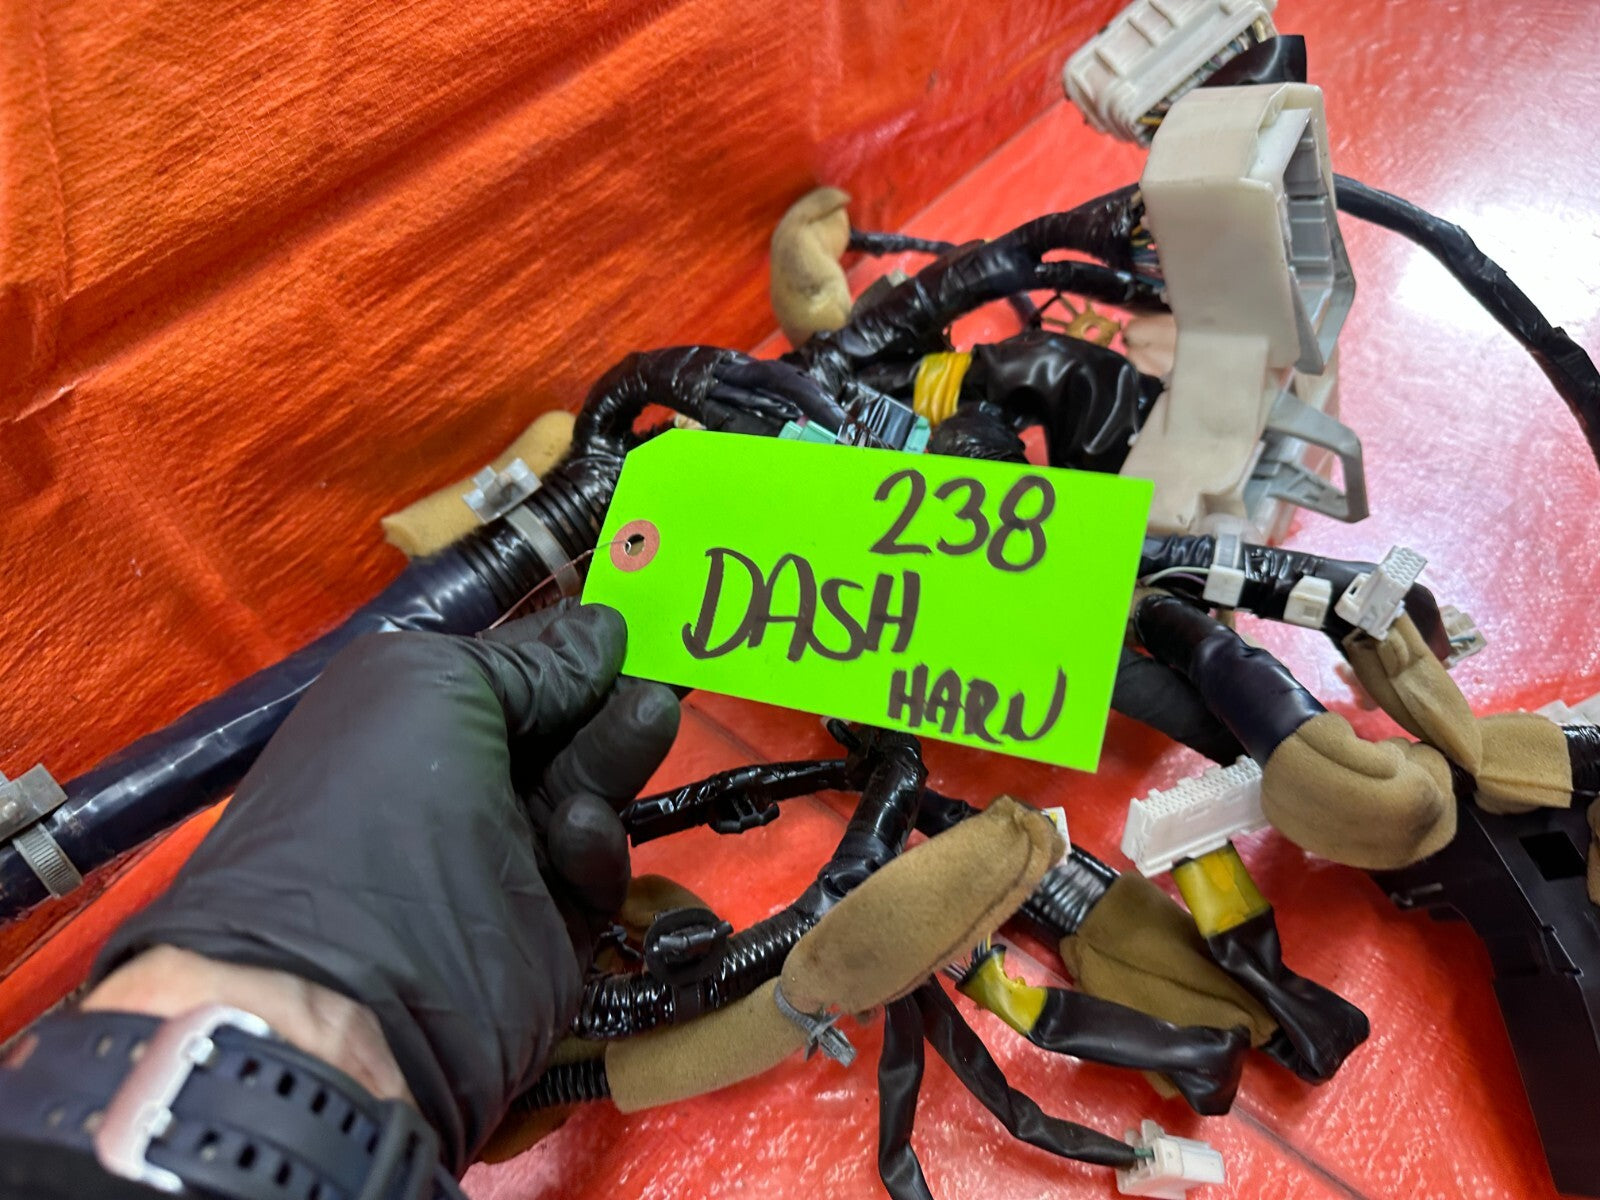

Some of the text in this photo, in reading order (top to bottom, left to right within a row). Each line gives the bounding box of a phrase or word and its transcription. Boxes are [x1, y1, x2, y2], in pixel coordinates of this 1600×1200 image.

[870, 468, 1056, 573] 238
[681, 548, 922, 662] DASH
[887, 663, 1067, 744] HARN
